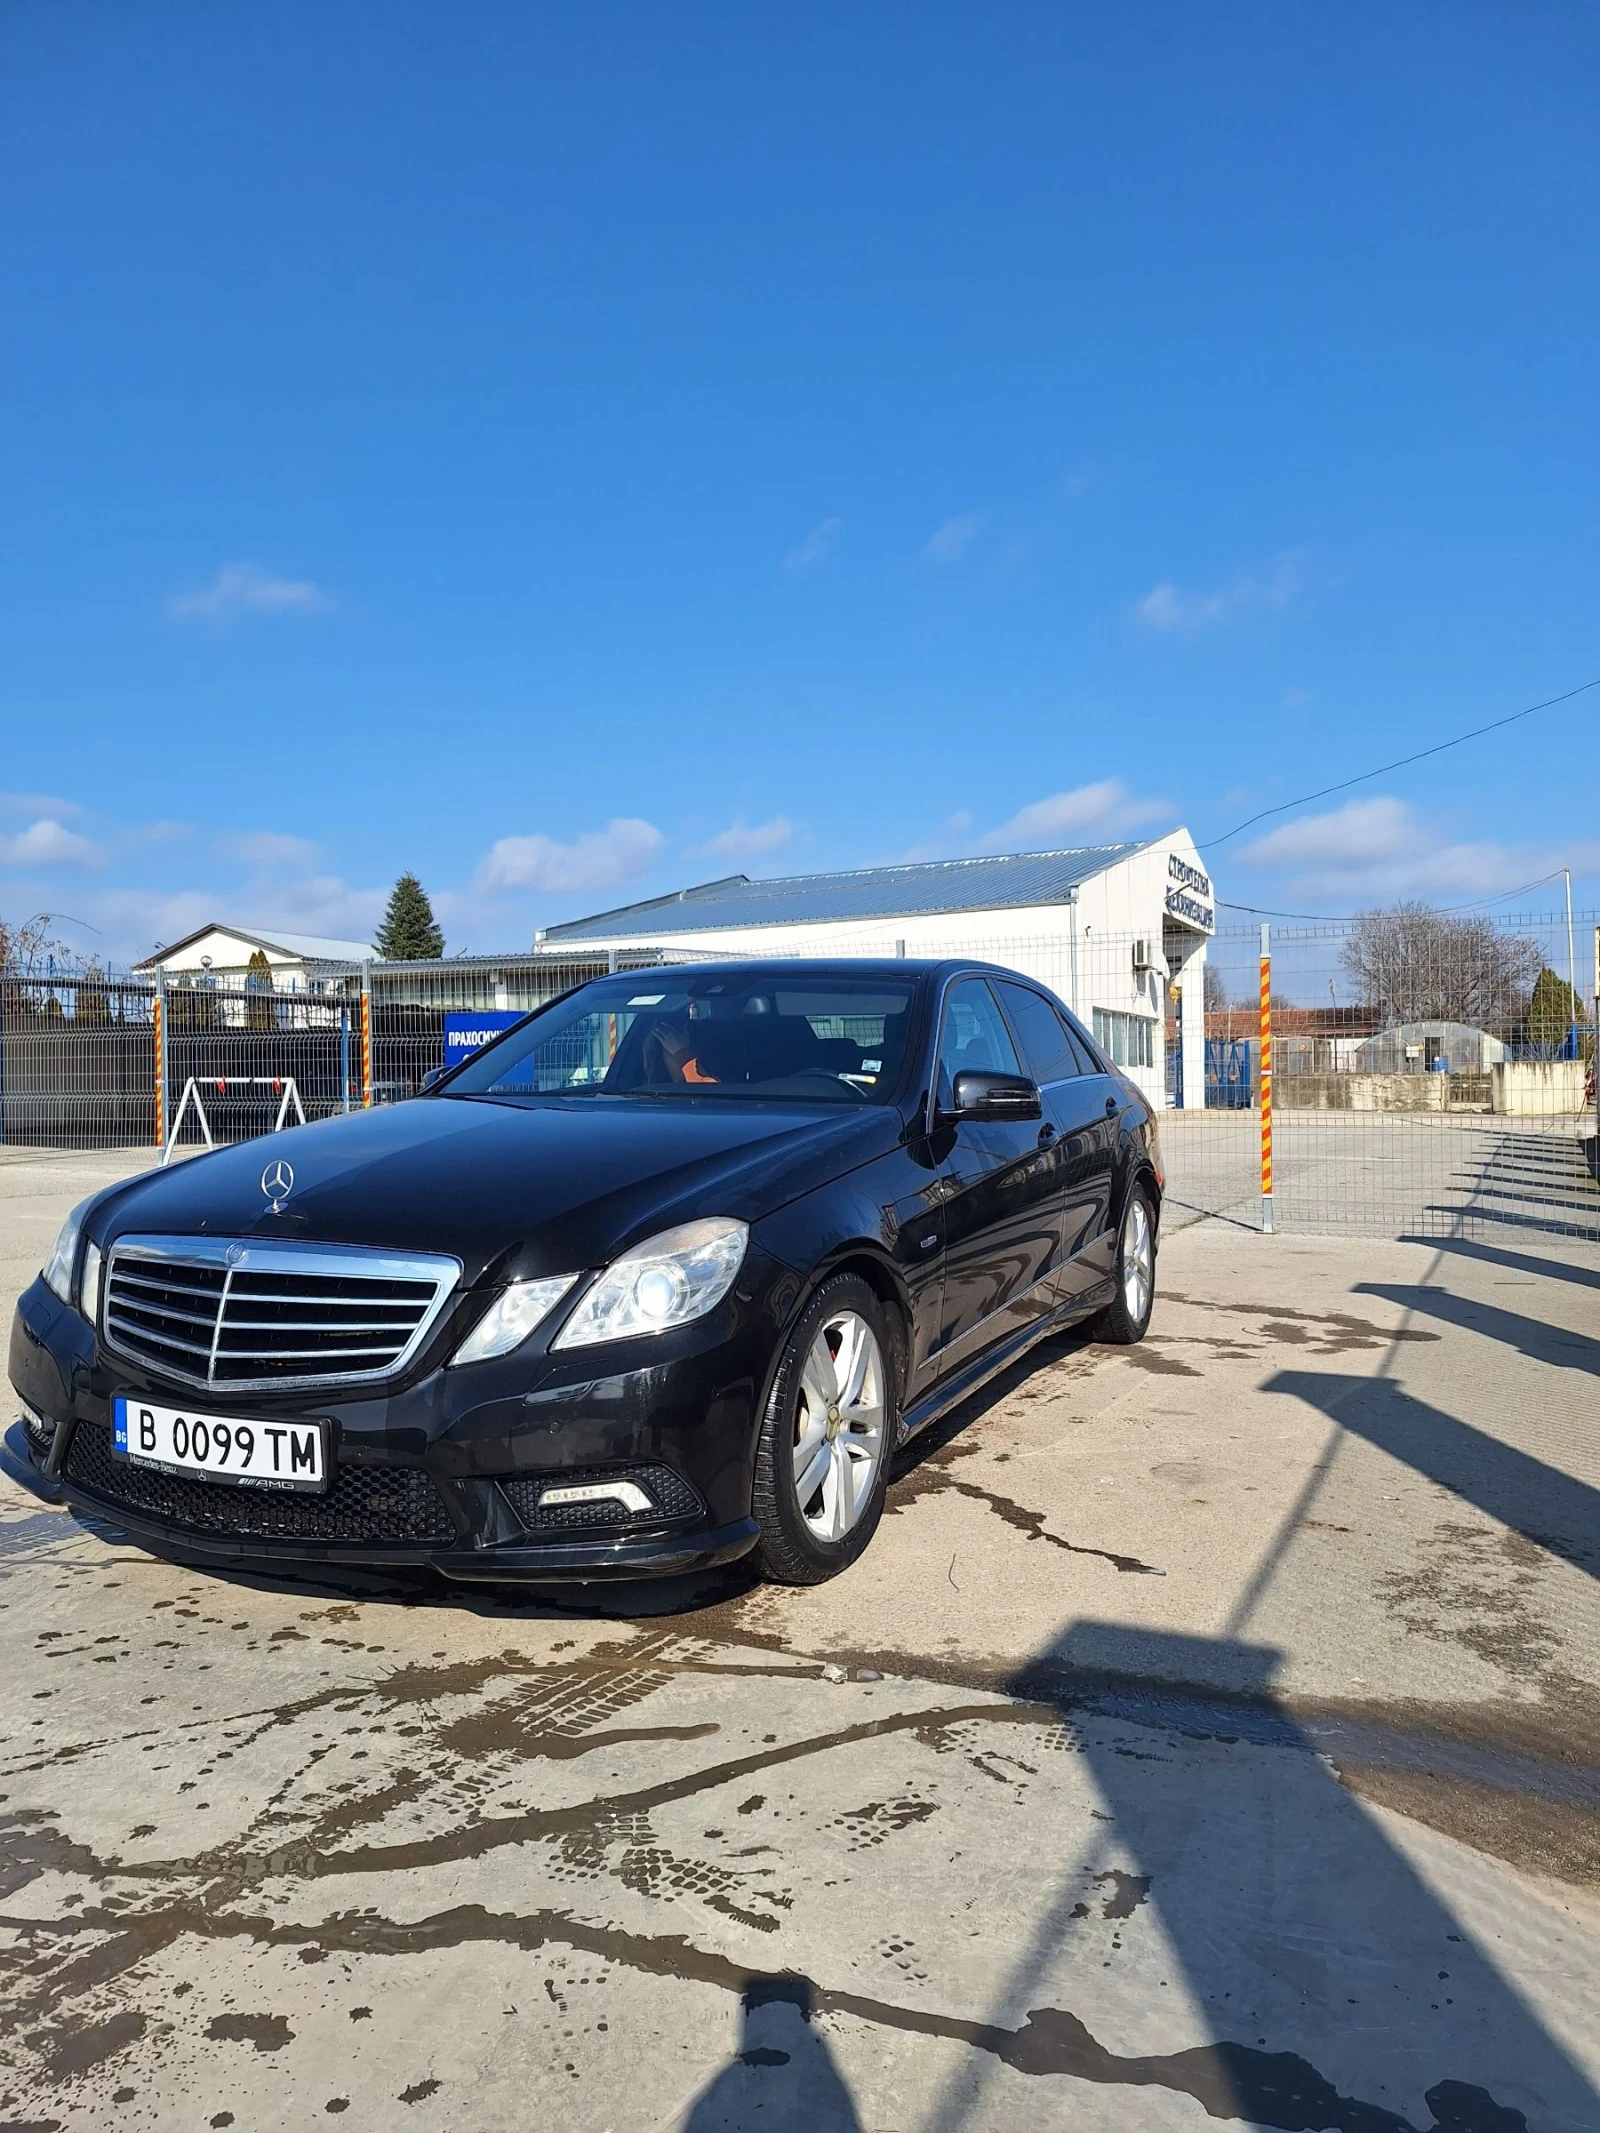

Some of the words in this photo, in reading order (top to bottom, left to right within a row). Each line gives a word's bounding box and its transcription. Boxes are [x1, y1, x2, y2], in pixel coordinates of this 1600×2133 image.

[116, 1430, 127, 1443] BG
[140, 1408, 156, 1451] B
[172, 1417, 255, 1468] 0099
[264, 1428, 315, 1474] TM
[129, 1453, 178, 1475] Mercedes-Benz
